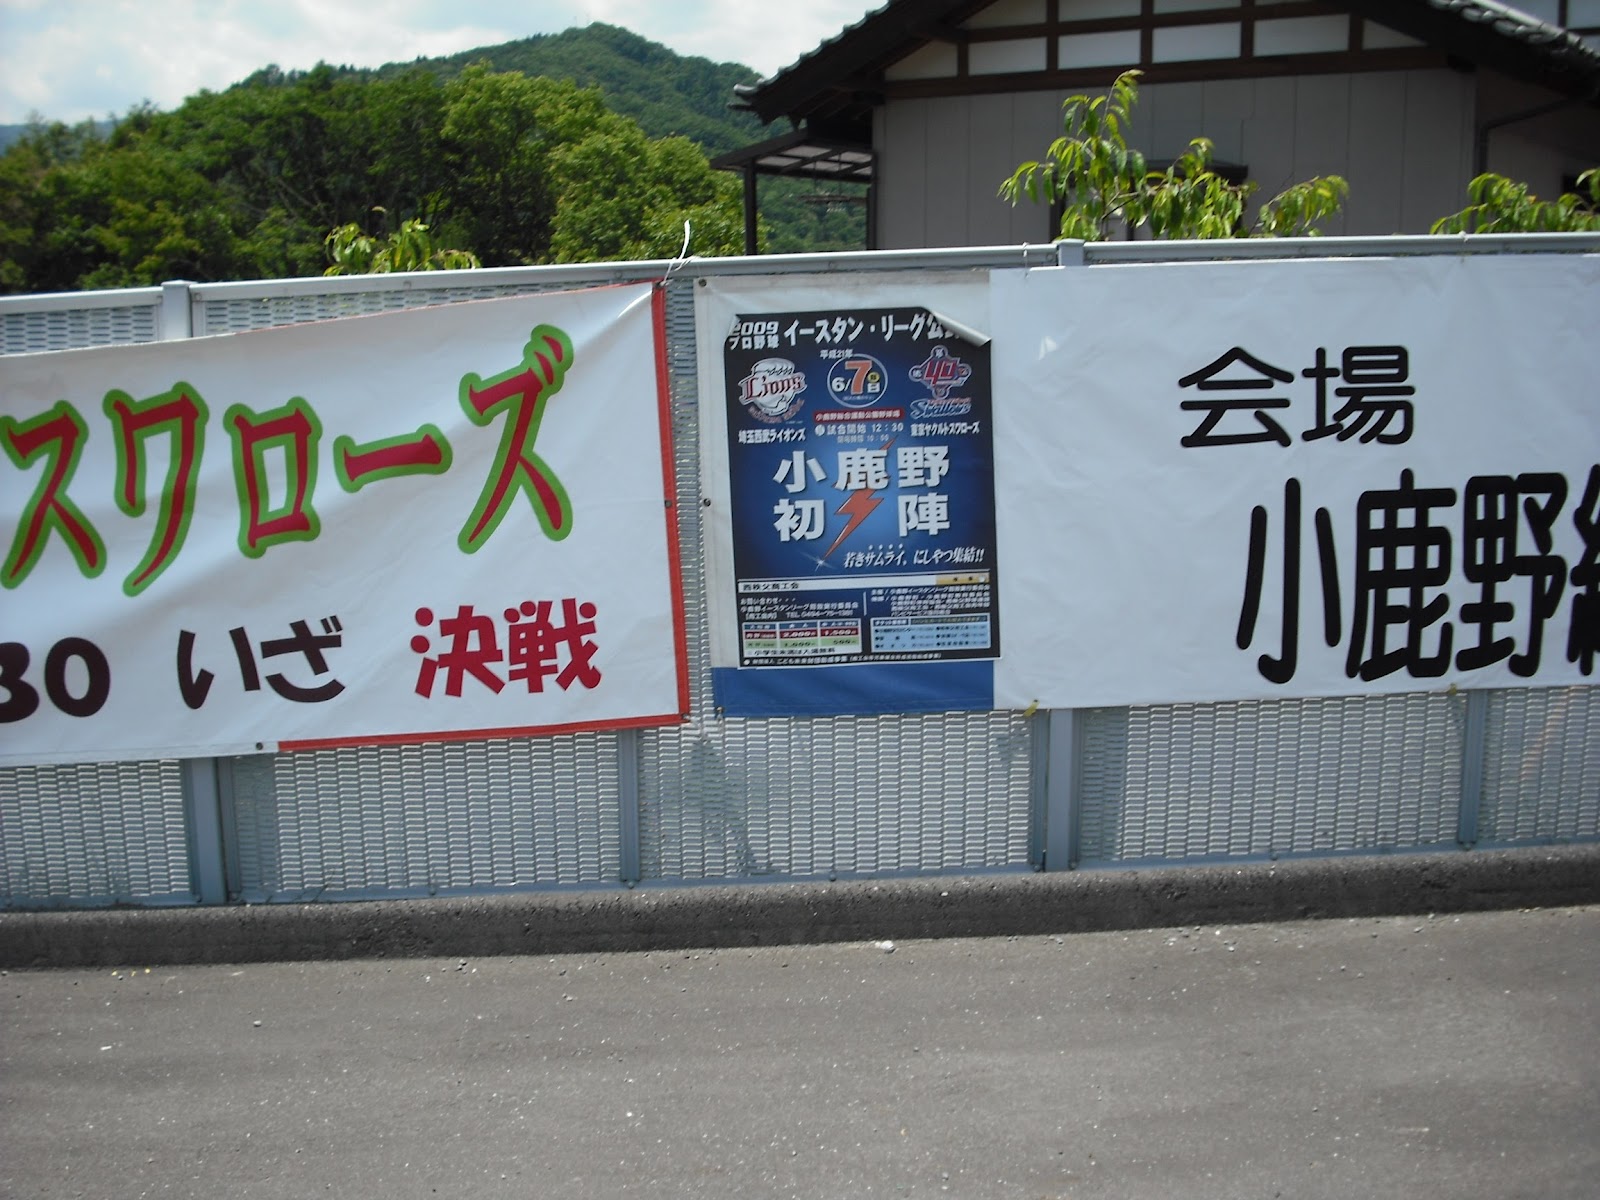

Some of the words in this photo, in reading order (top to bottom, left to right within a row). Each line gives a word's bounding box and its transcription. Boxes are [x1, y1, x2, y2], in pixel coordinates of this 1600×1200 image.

[729, 334, 780, 351] プロ野球
[1179, 345, 1416, 448] 会場
[0, 324, 575, 598] スワローズ
[772, 445, 950, 494] 小鹿野
[175, 613, 347, 710] いざ
[409, 597, 604, 700] 決戦
